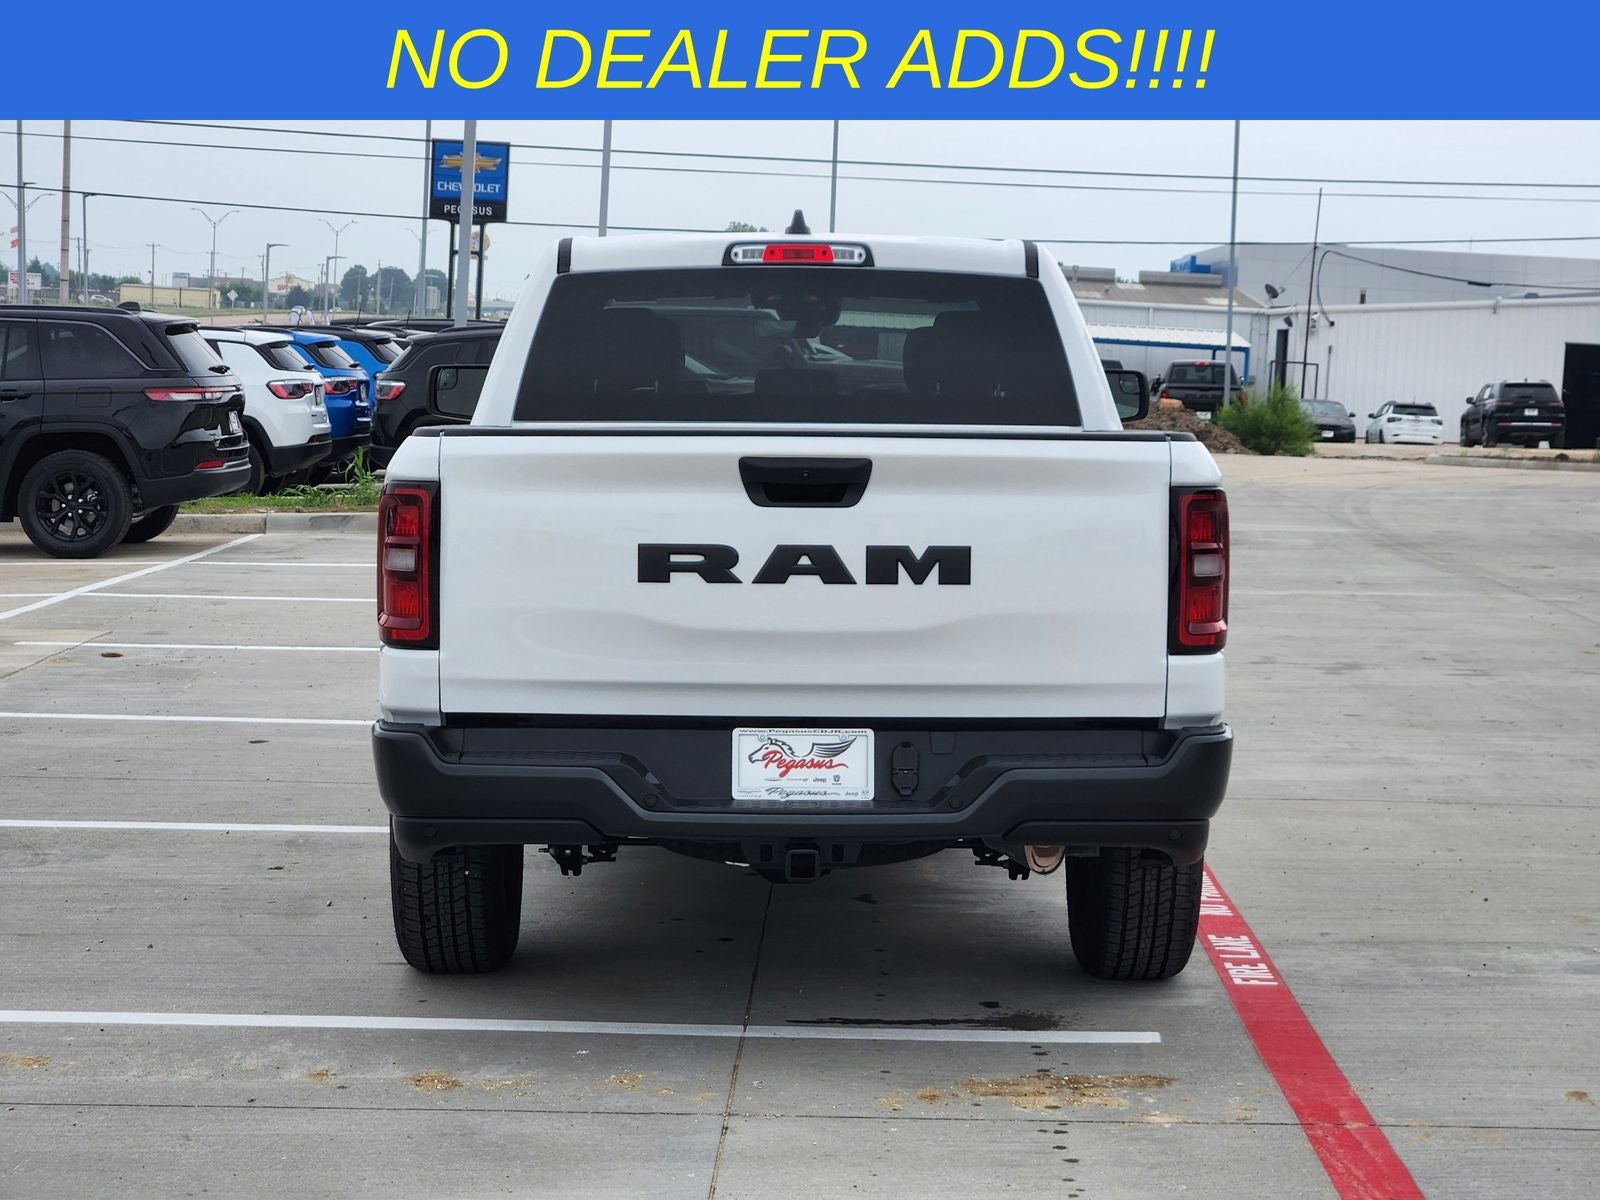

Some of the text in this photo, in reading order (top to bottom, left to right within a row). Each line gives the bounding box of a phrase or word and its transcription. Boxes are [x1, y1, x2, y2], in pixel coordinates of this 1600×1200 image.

[437, 181, 501, 193] CHEOLET
[444, 204, 493, 215] PESUS
[638, 543, 971, 585] RAM
[762, 750, 848, 778] Pegasus
[765, 787, 841, 799] Pegasus
[1207, 934, 1261, 959] LANE
[1223, 961, 1280, 986] FIRE
